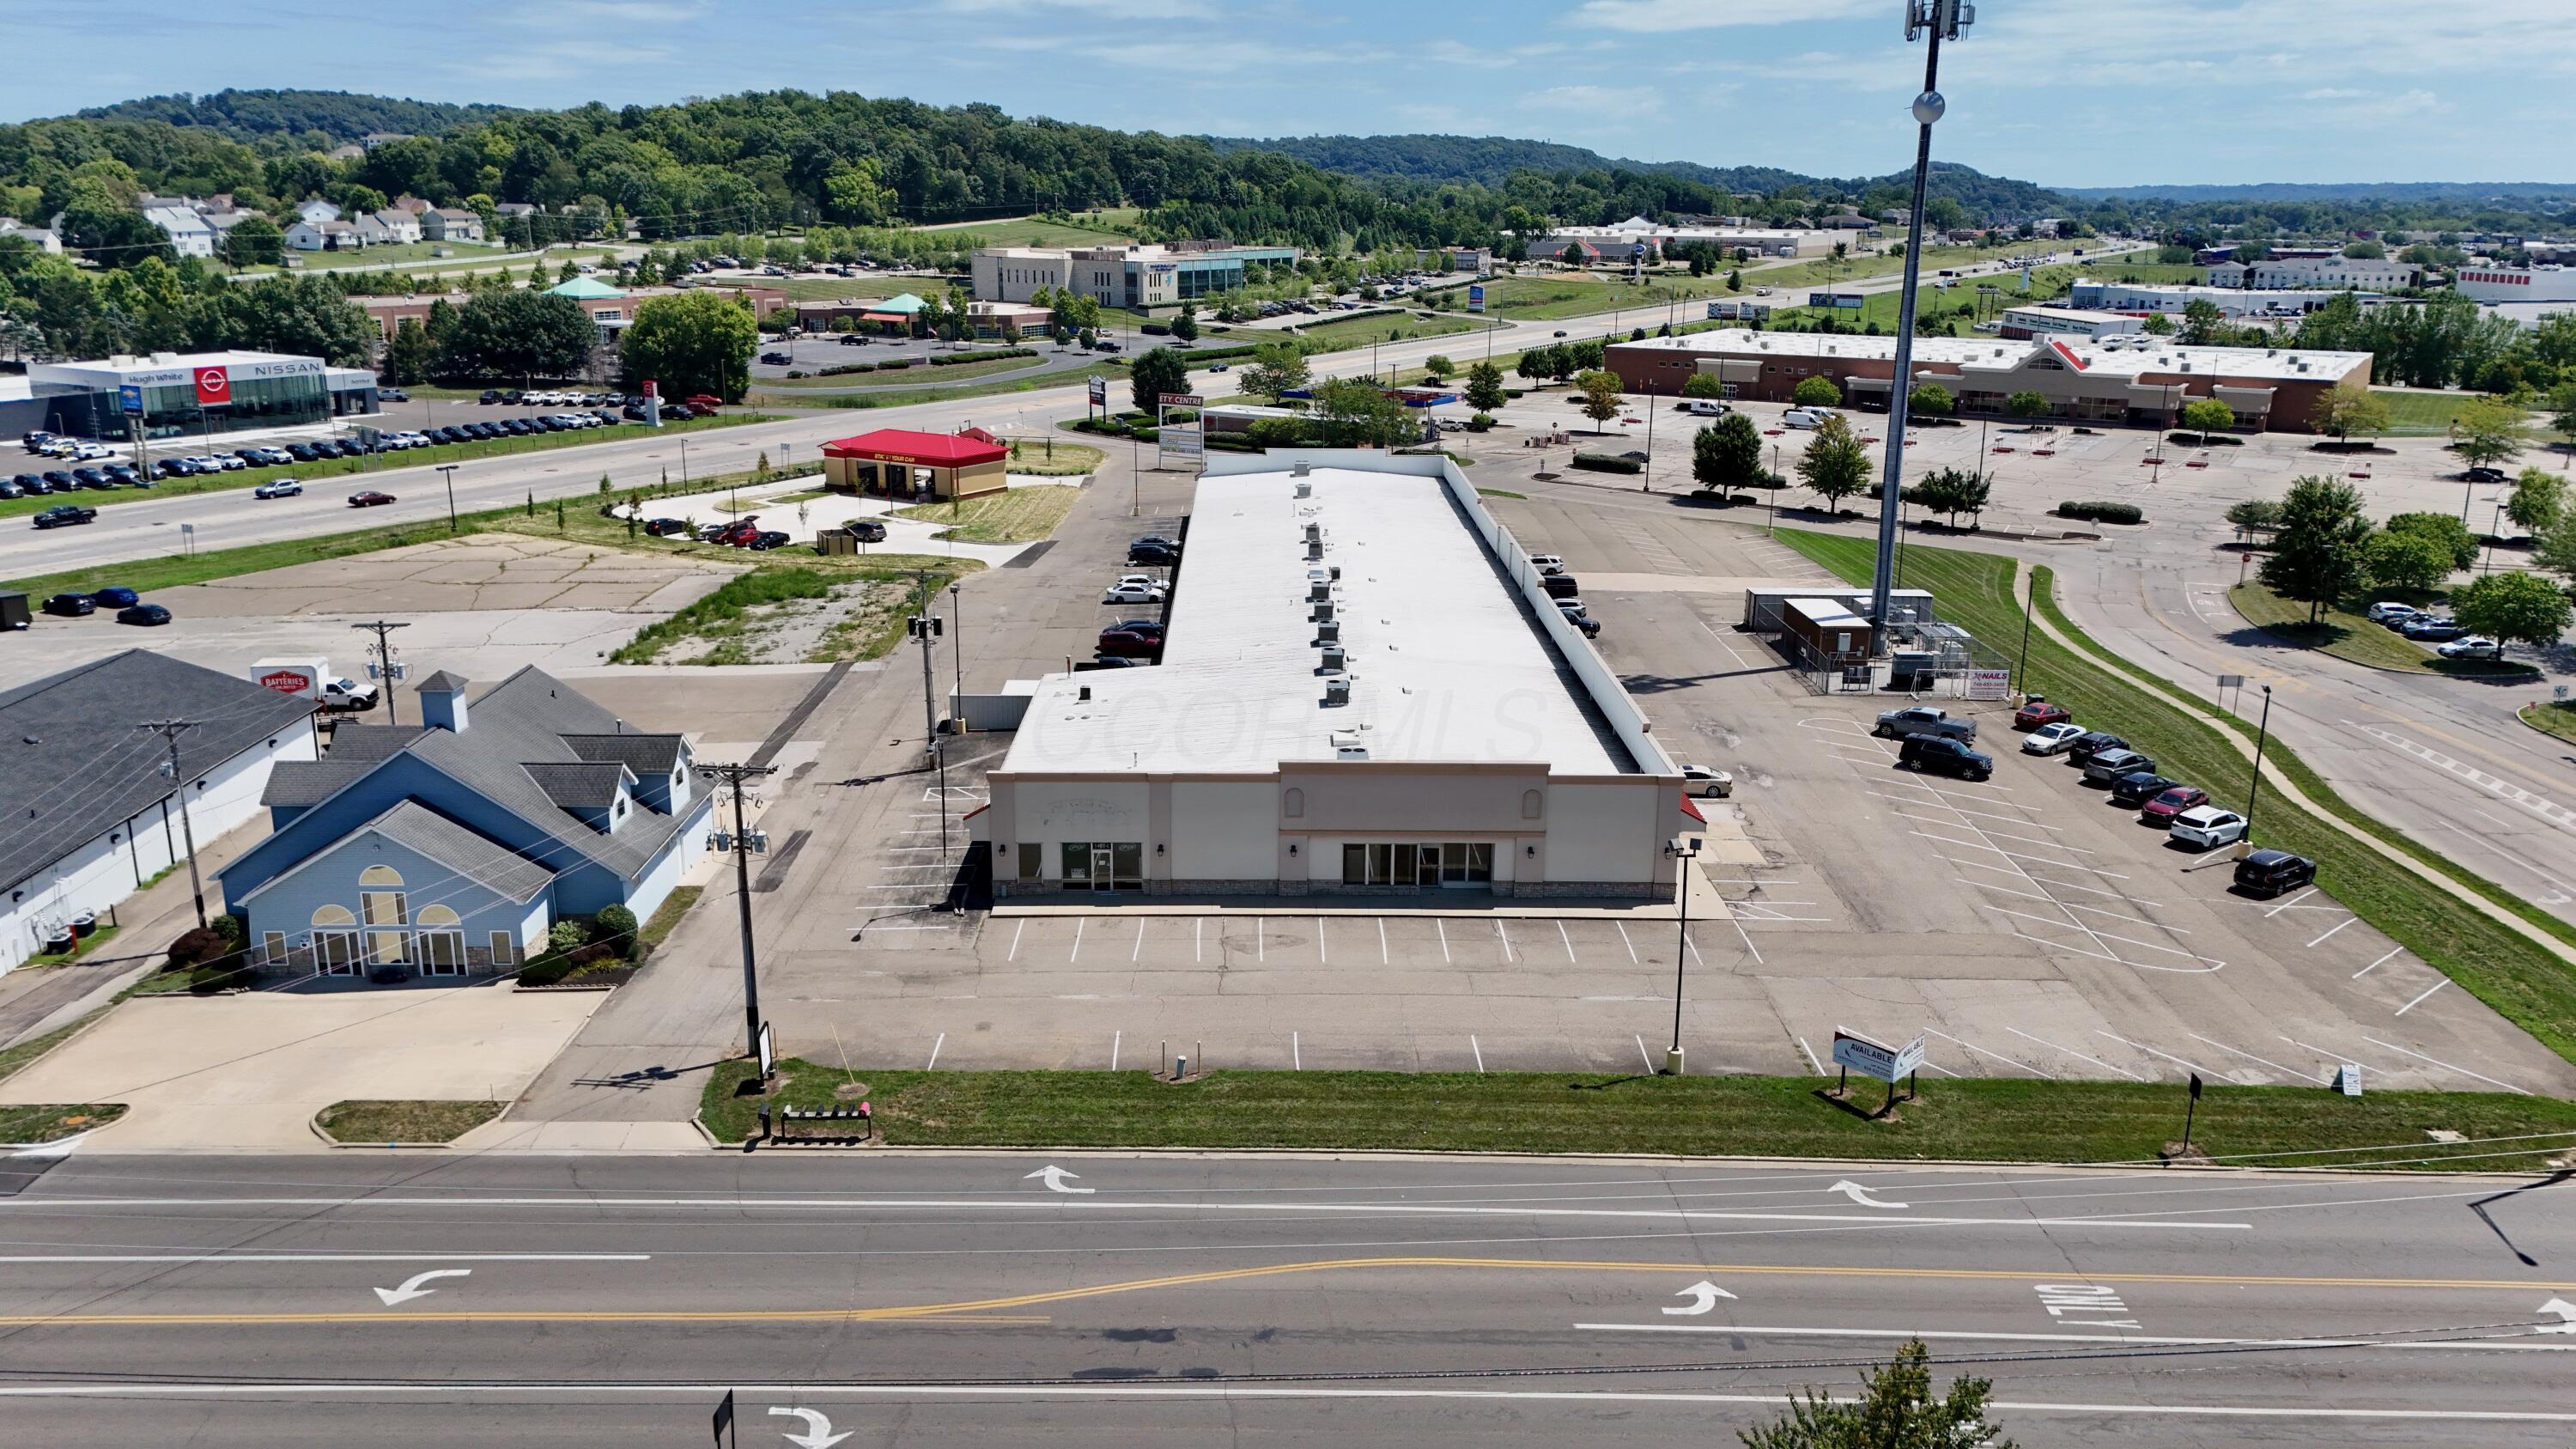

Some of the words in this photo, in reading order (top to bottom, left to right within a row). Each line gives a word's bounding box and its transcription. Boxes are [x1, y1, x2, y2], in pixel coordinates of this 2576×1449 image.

[255, 362, 320, 375] NISSAN
[129, 374, 155, 384] Hugh
[156, 373, 184, 382] White
[1175, 396, 1202, 405] CENTRE
[265, 678, 305, 686] BATTERIES
[1850, 1043, 1893, 1063] AVAILABLE
[1904, 1038, 1923, 1057] AVAILABLE
[2032, 1284, 2143, 1329] ONLY
